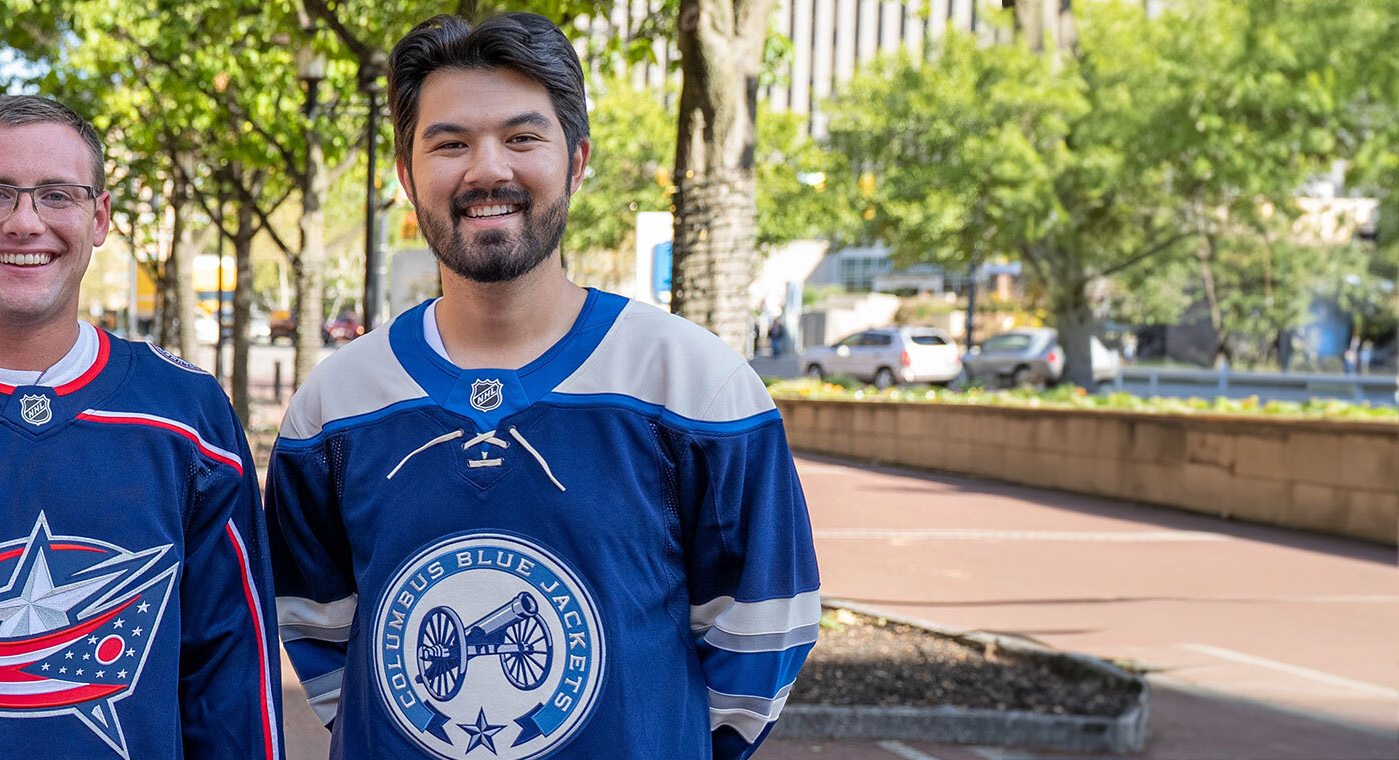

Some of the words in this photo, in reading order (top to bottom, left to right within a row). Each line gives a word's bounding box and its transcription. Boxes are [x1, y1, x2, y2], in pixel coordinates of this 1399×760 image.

[477, 387, 496, 405] NHL
[28, 402, 45, 418] NHL
[385, 561, 445, 709] COLUMBUS
[456, 550, 536, 576] BLUE
[539, 579, 588, 713] JACKETS
